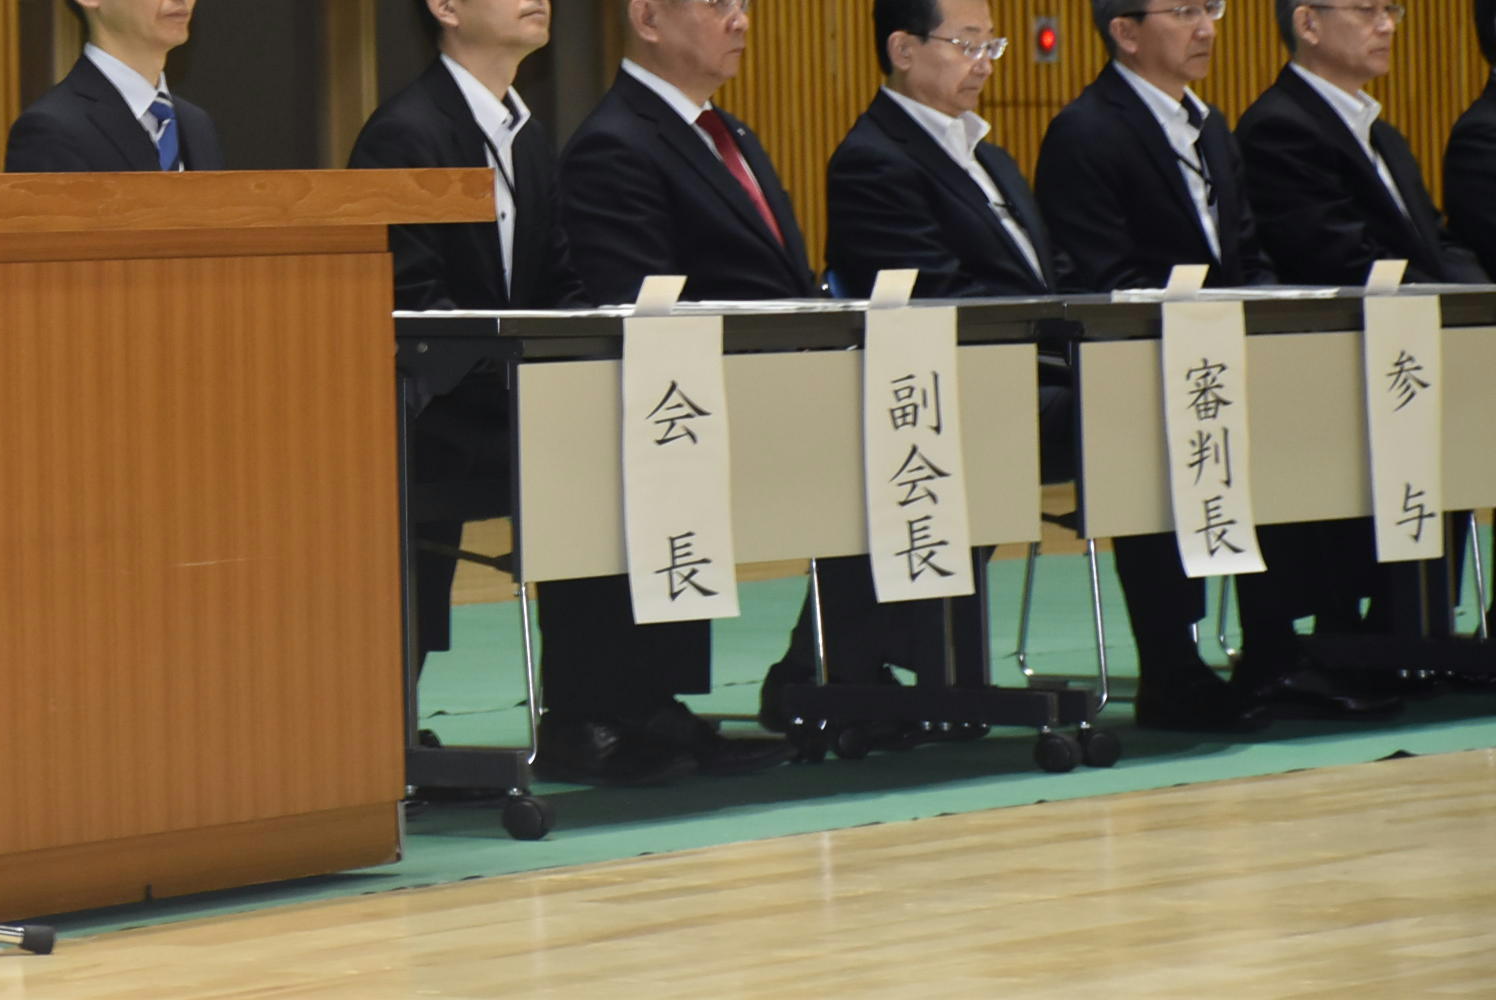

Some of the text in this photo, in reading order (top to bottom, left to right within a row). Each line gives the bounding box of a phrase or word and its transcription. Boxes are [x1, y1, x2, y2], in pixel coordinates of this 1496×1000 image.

[646, 380, 719, 601] 会長
[888, 370, 956, 583] 副会長
[1186, 358, 1245, 557] 審判長
[1386, 350, 1437, 543] 参与
